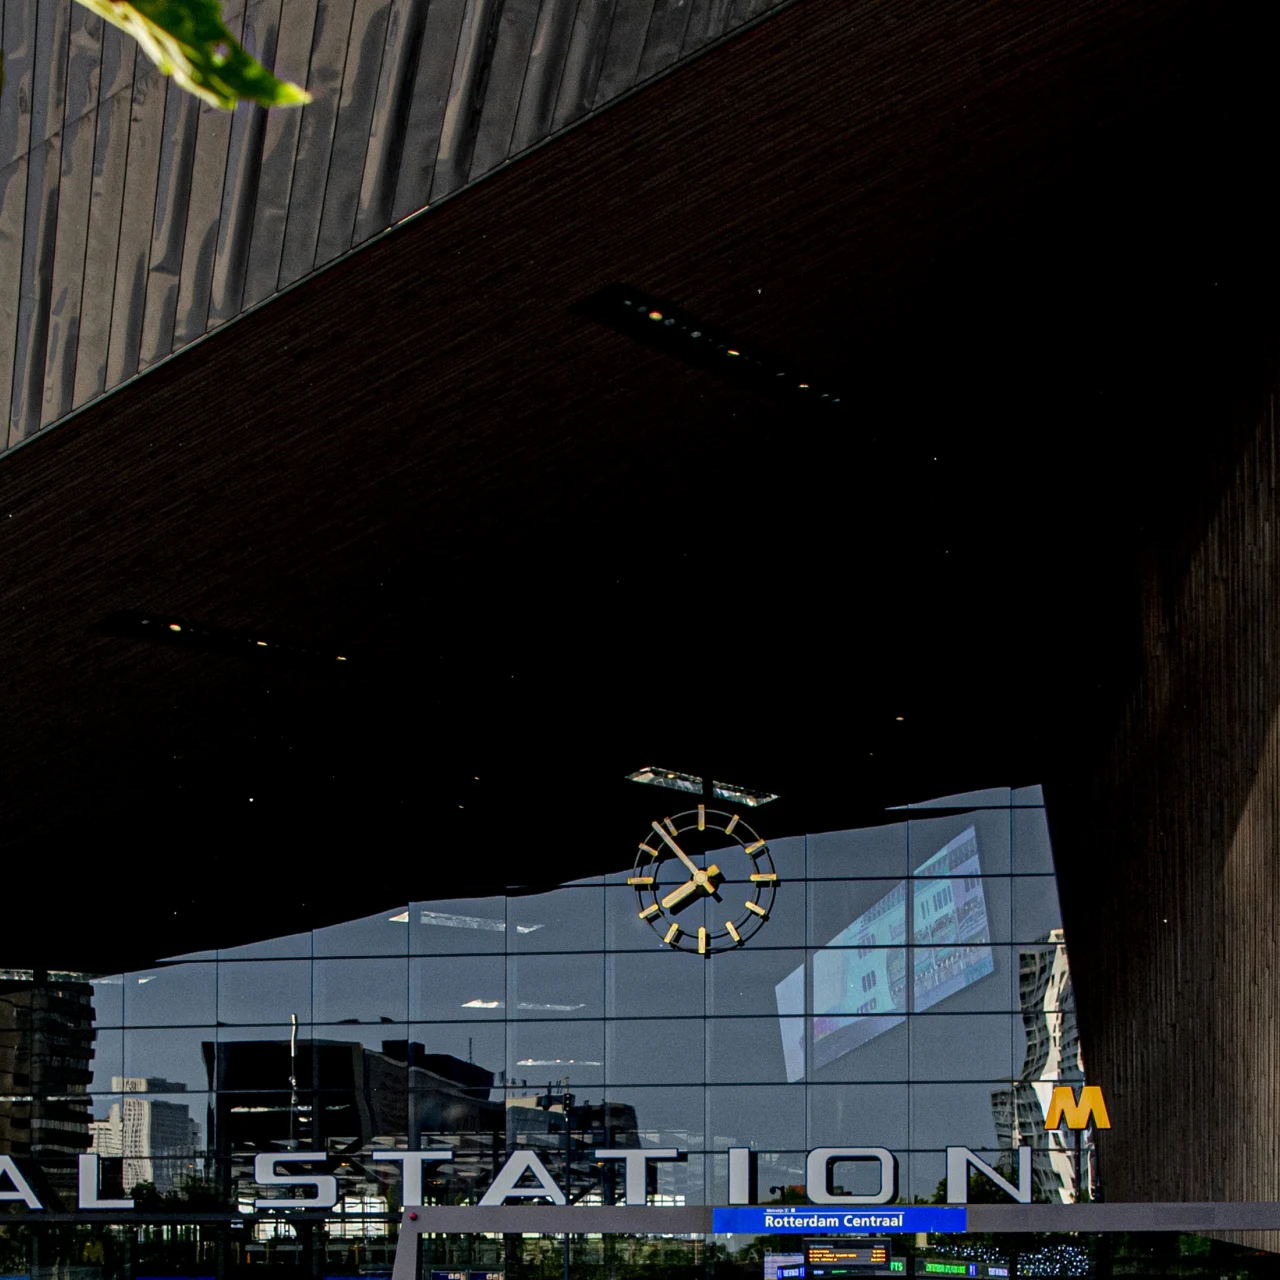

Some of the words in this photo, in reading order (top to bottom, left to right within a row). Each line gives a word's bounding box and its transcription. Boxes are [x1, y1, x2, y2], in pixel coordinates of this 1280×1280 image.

[254, 1145, 1033, 1208] STATION
[765, 1214, 839, 1228] Rotterdam
[844, 1214, 903, 1227] Centraal
